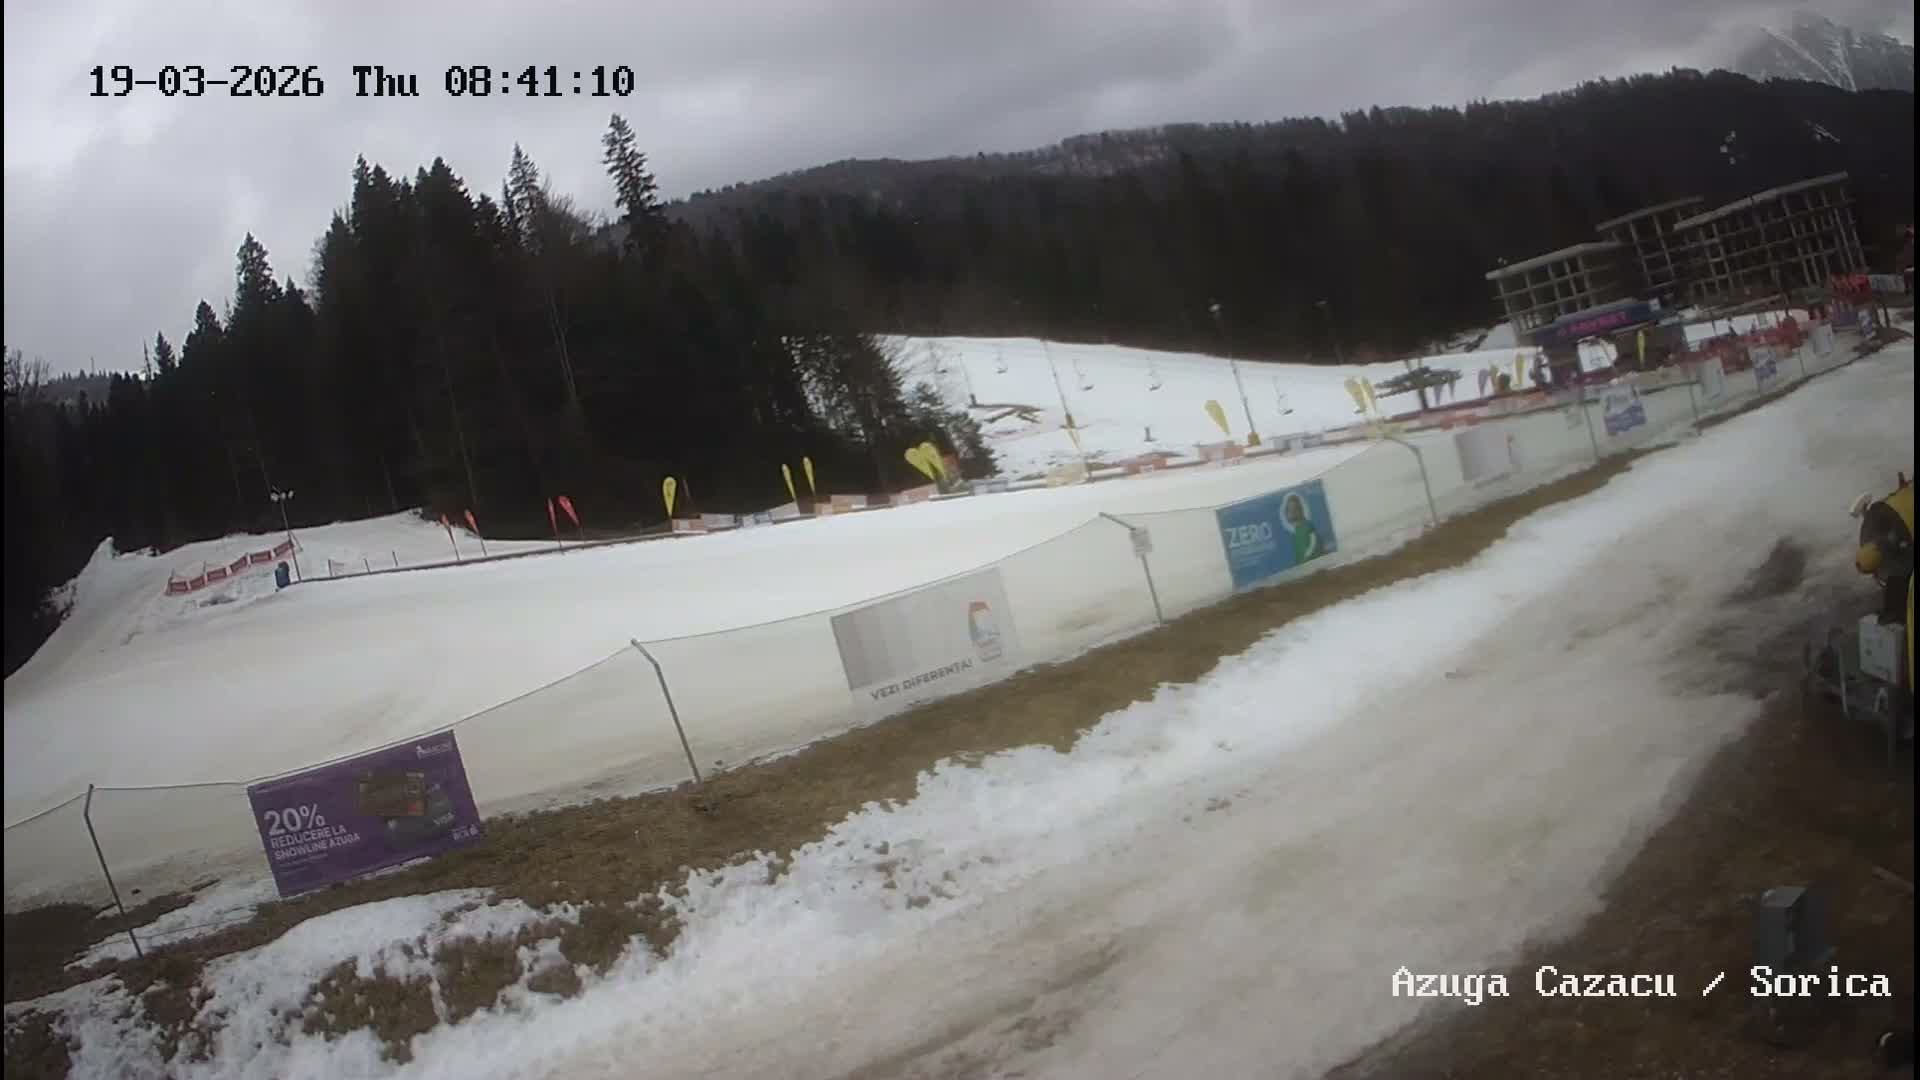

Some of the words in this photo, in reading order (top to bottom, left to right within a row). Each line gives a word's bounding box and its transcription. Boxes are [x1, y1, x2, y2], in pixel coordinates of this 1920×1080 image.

[1224, 521, 1273, 549] ZERO
[869, 684, 901, 701] VEZI
[263, 803, 326, 836] 20%
[270, 826, 331, 849] REDUCERE
[331, 824, 347, 836] LA
